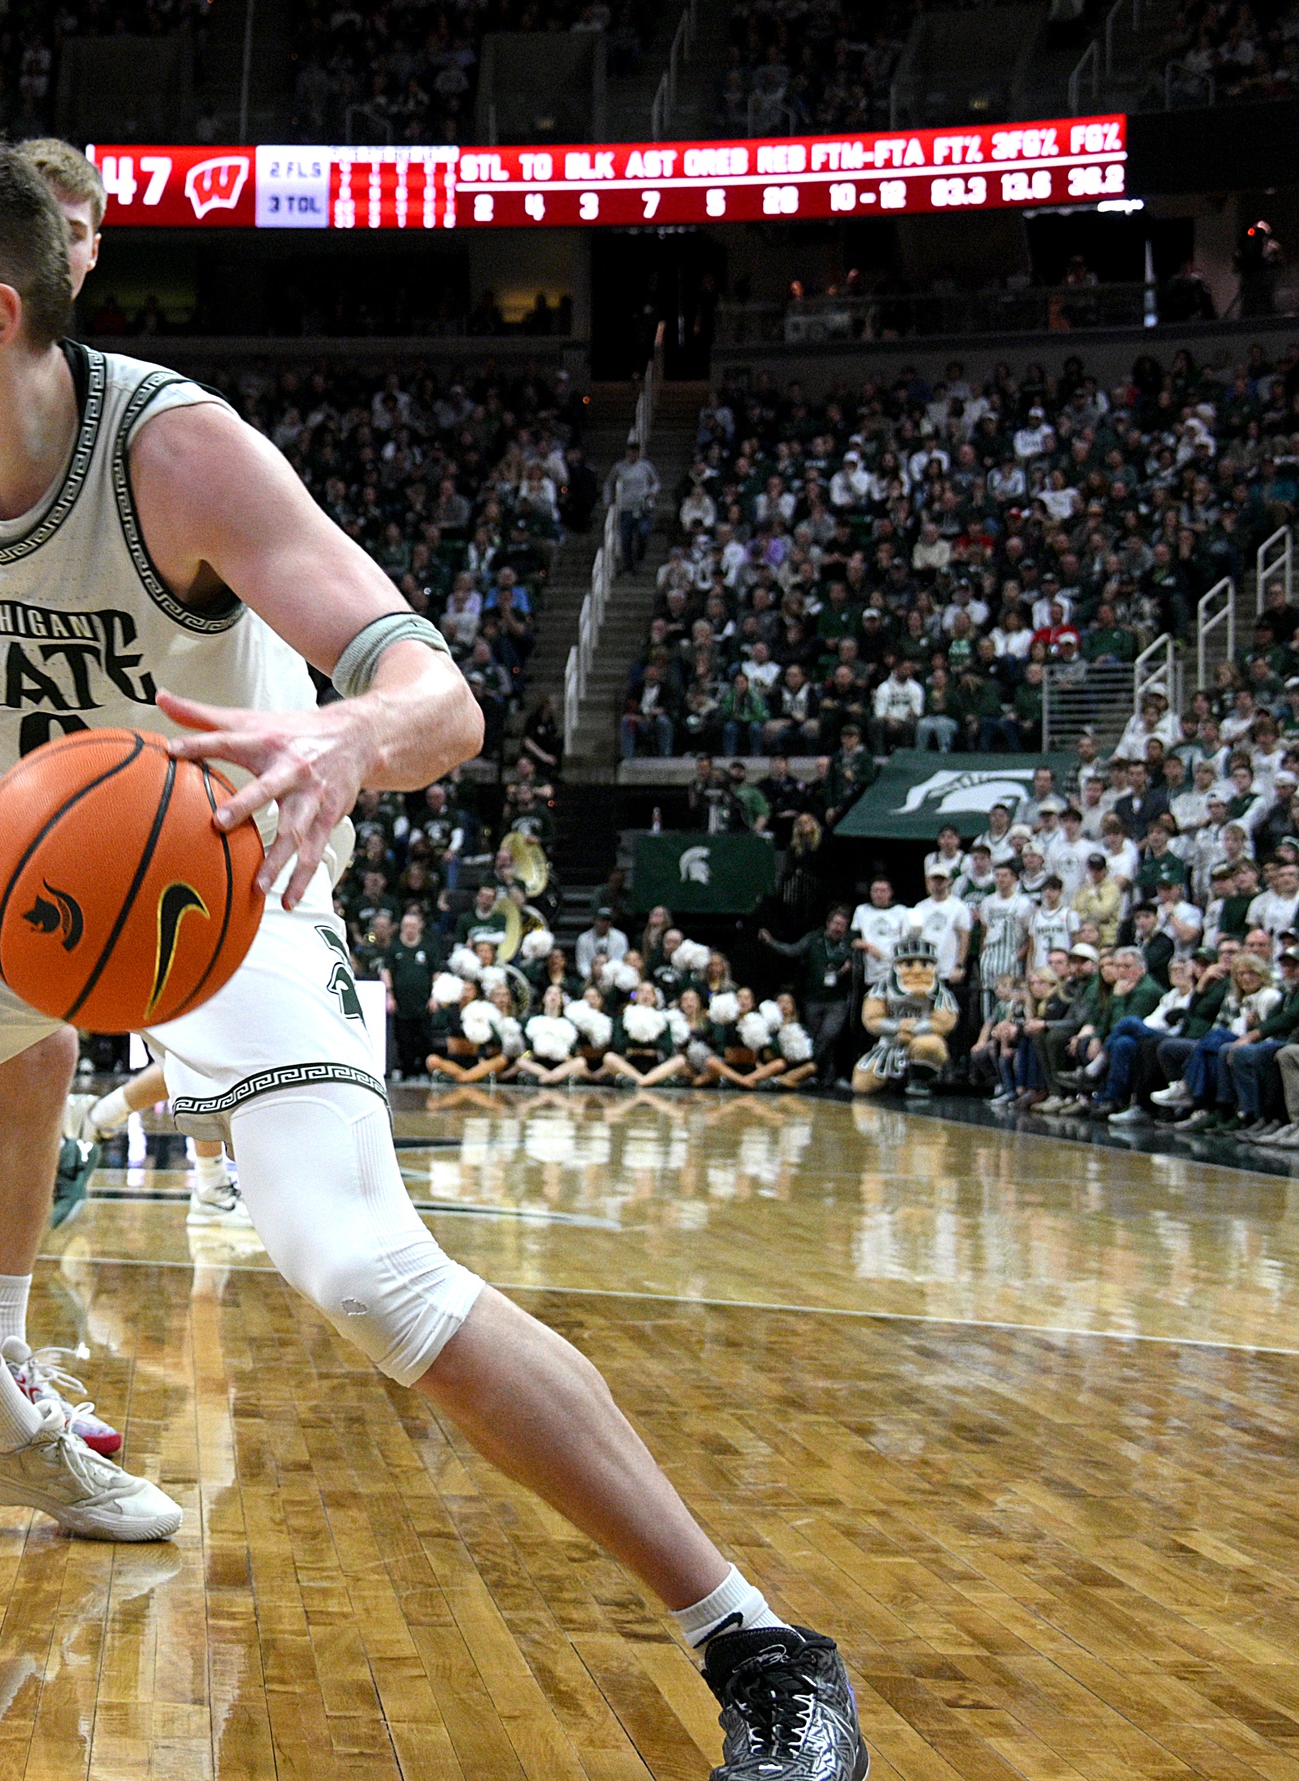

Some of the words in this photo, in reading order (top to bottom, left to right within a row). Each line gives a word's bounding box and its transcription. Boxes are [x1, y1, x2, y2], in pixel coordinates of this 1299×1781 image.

[285, 161, 322, 178] FLS
[459, 153, 510, 182] STL
[518, 152, 553, 181] TO
[564, 151, 616, 180] BLK
[624, 149, 678, 179] AST
[757, 144, 807, 174] REB
[811, 137, 925, 171] FTM-FTA
[933, 134, 984, 165] FT%
[101, 156, 173, 206] 47
[287, 196, 322, 214] TOL
[524, 193, 546, 221] 4
[578, 191, 600, 220] 3
[640, 190, 661, 218] 7
[705, 188, 726, 217] 5
